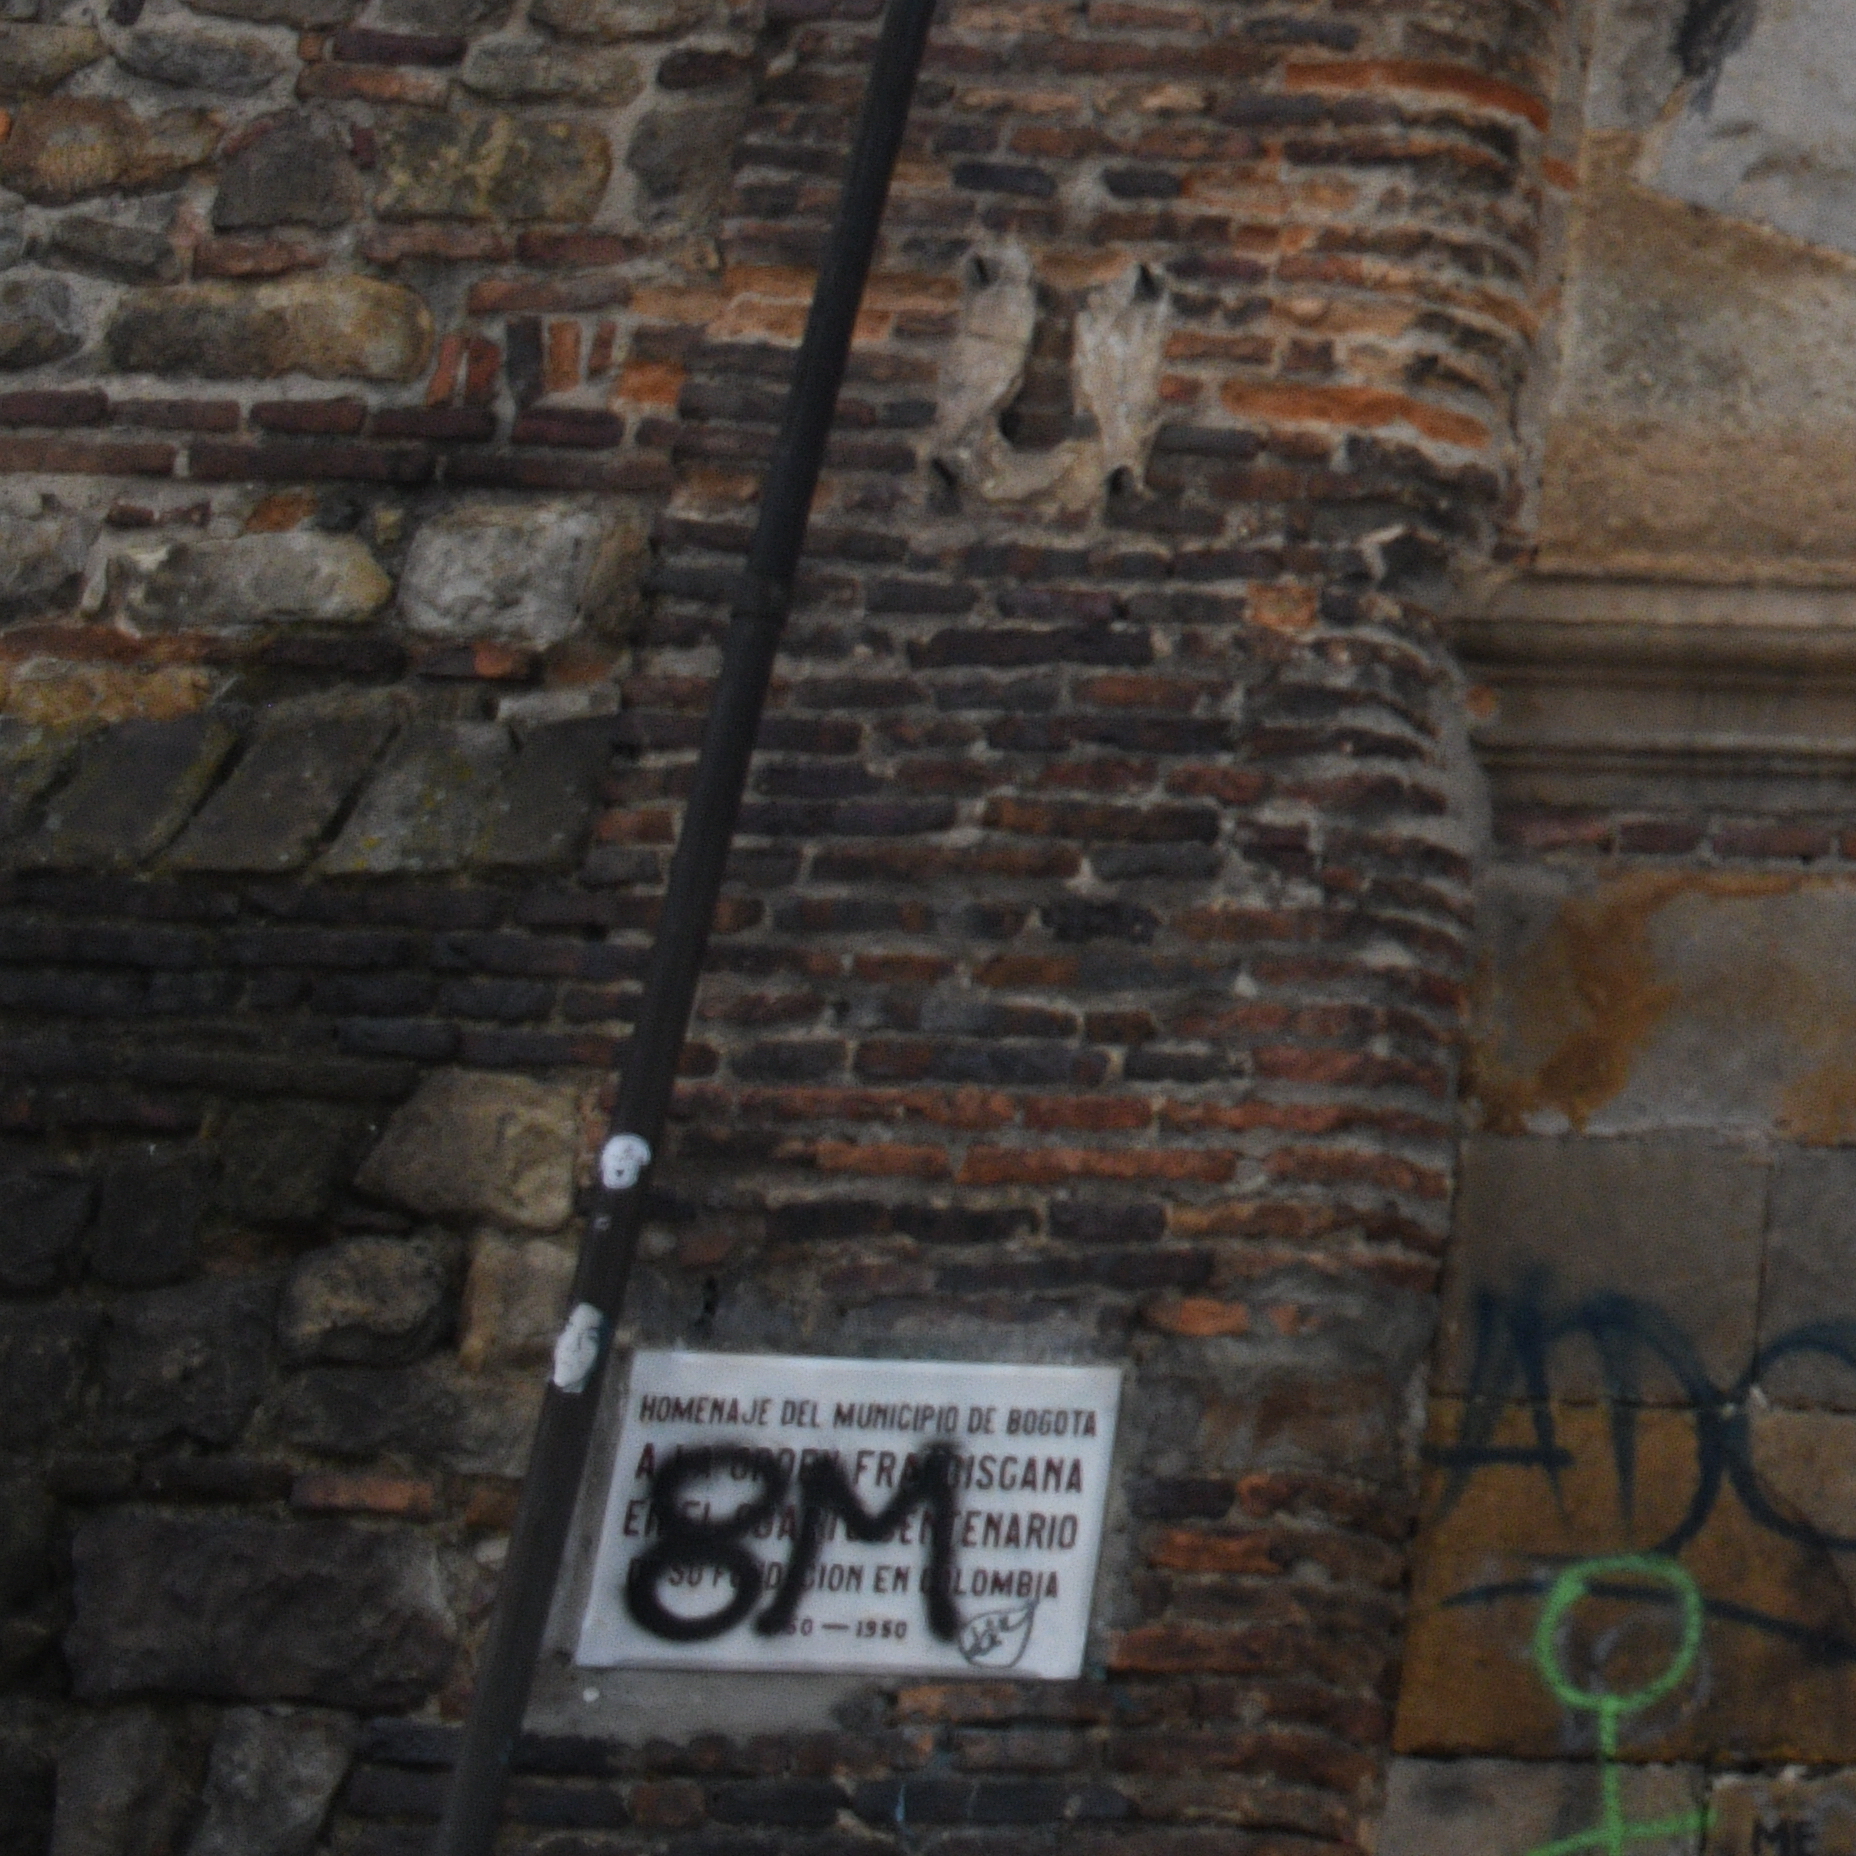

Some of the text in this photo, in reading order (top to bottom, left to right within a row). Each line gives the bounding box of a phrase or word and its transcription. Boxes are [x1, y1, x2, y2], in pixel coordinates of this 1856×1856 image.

[638, 1394, 1096, 1438] HOMENAJE DEL MUNICIPIO DE BOGOTA
[634, 1443, 656, 1480] A
[853, 1449, 1083, 1494] FRACISCANA
[624, 1438, 962, 1643] 8M
[878, 1507, 1079, 1550] ENTENARIO
[873, 1564, 911, 1594] EN
[919, 1565, 1059, 1599] CLOMBIA
[855, 1618, 908, 1639] 1950
